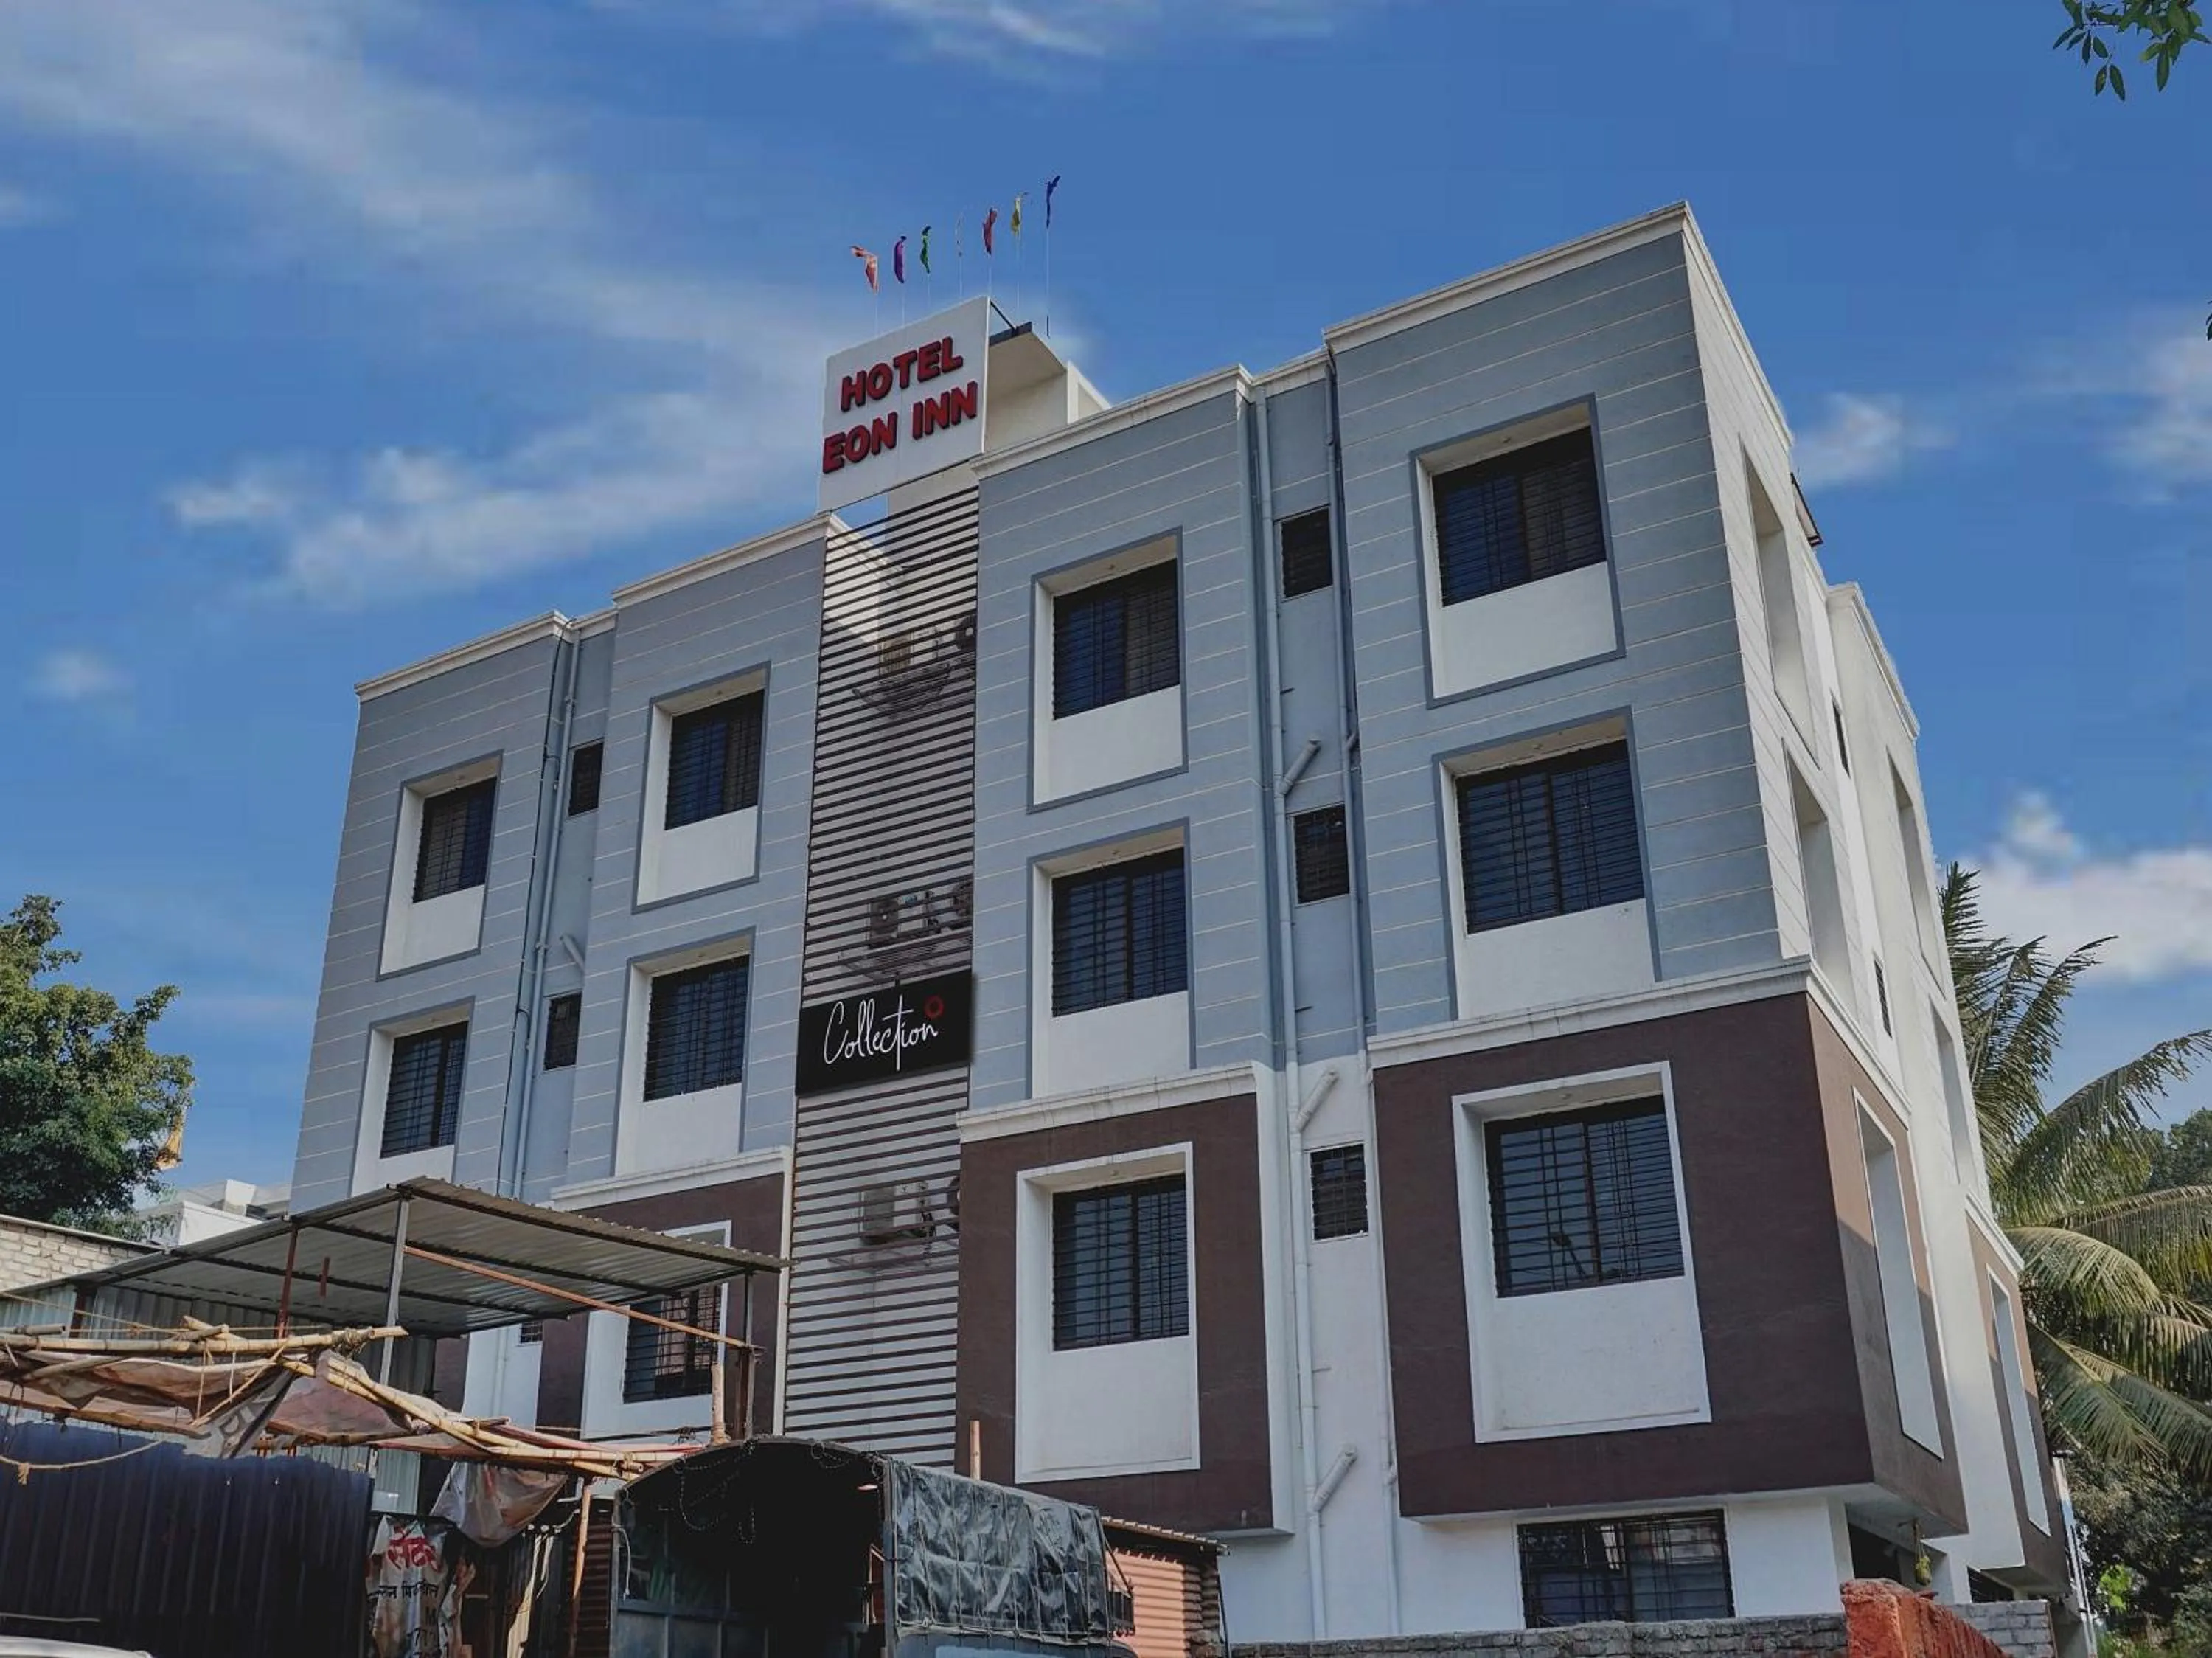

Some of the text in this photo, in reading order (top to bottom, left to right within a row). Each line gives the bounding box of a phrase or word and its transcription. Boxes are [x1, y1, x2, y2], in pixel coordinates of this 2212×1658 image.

[840, 336, 964, 412] HOTEL
[822, 381, 978, 474] EON INN
[824, 994, 939, 1071] Collection
